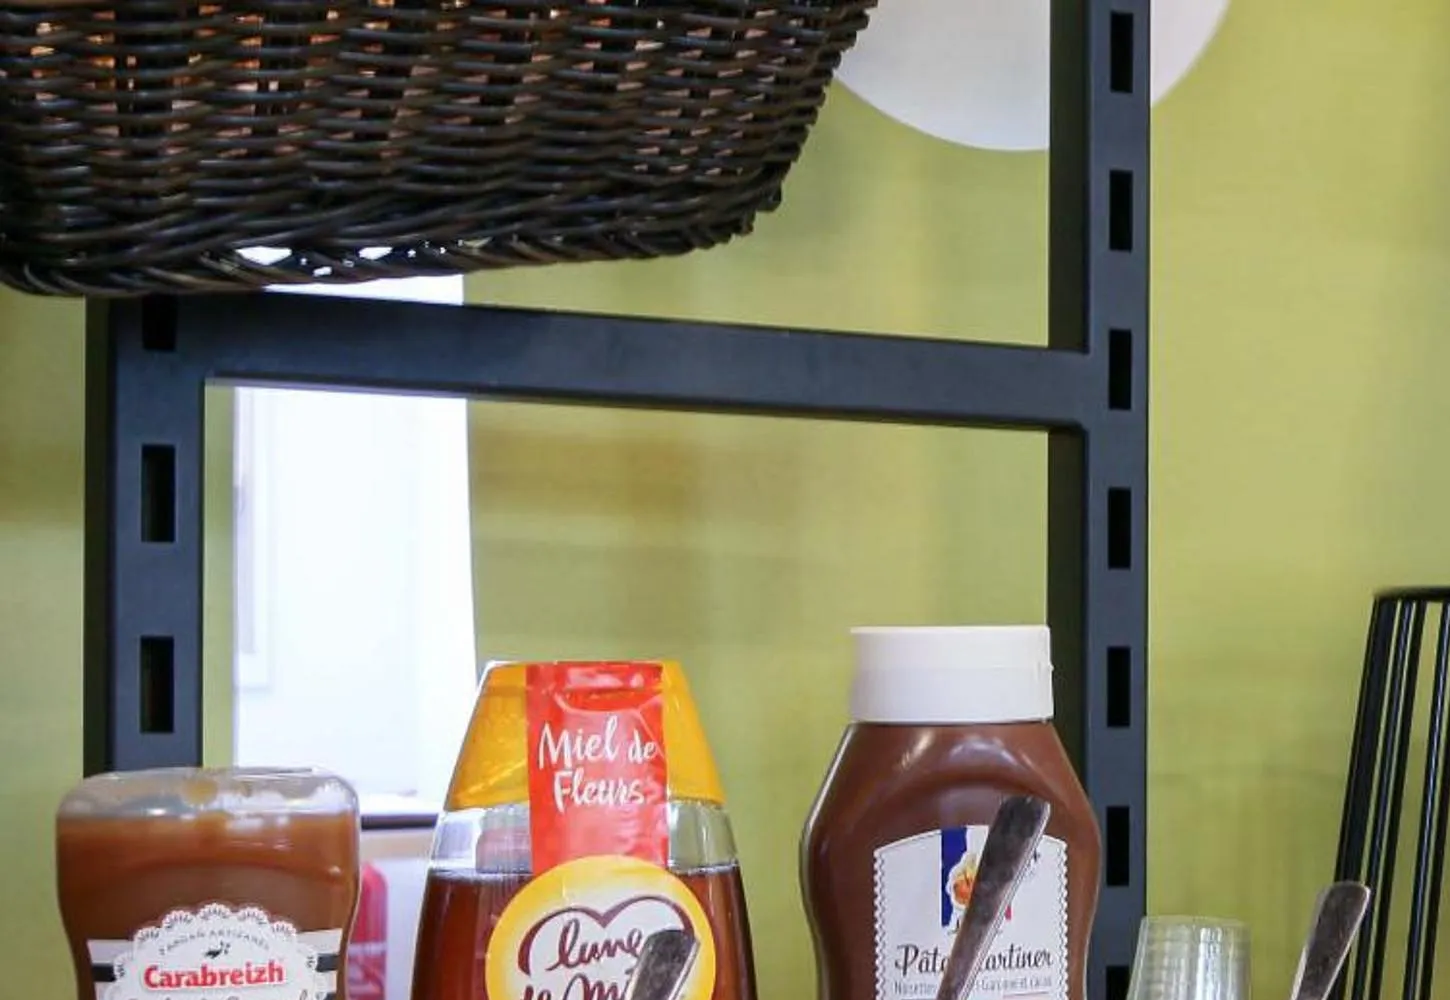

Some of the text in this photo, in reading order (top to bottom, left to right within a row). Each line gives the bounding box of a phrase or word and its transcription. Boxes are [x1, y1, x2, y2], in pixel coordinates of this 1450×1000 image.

[538, 715, 657, 770] Miel de
[552, 766, 645, 813] Fleurs
[143, 960, 284, 989] Carabreizh
[979, 942, 1055, 971] artiner
